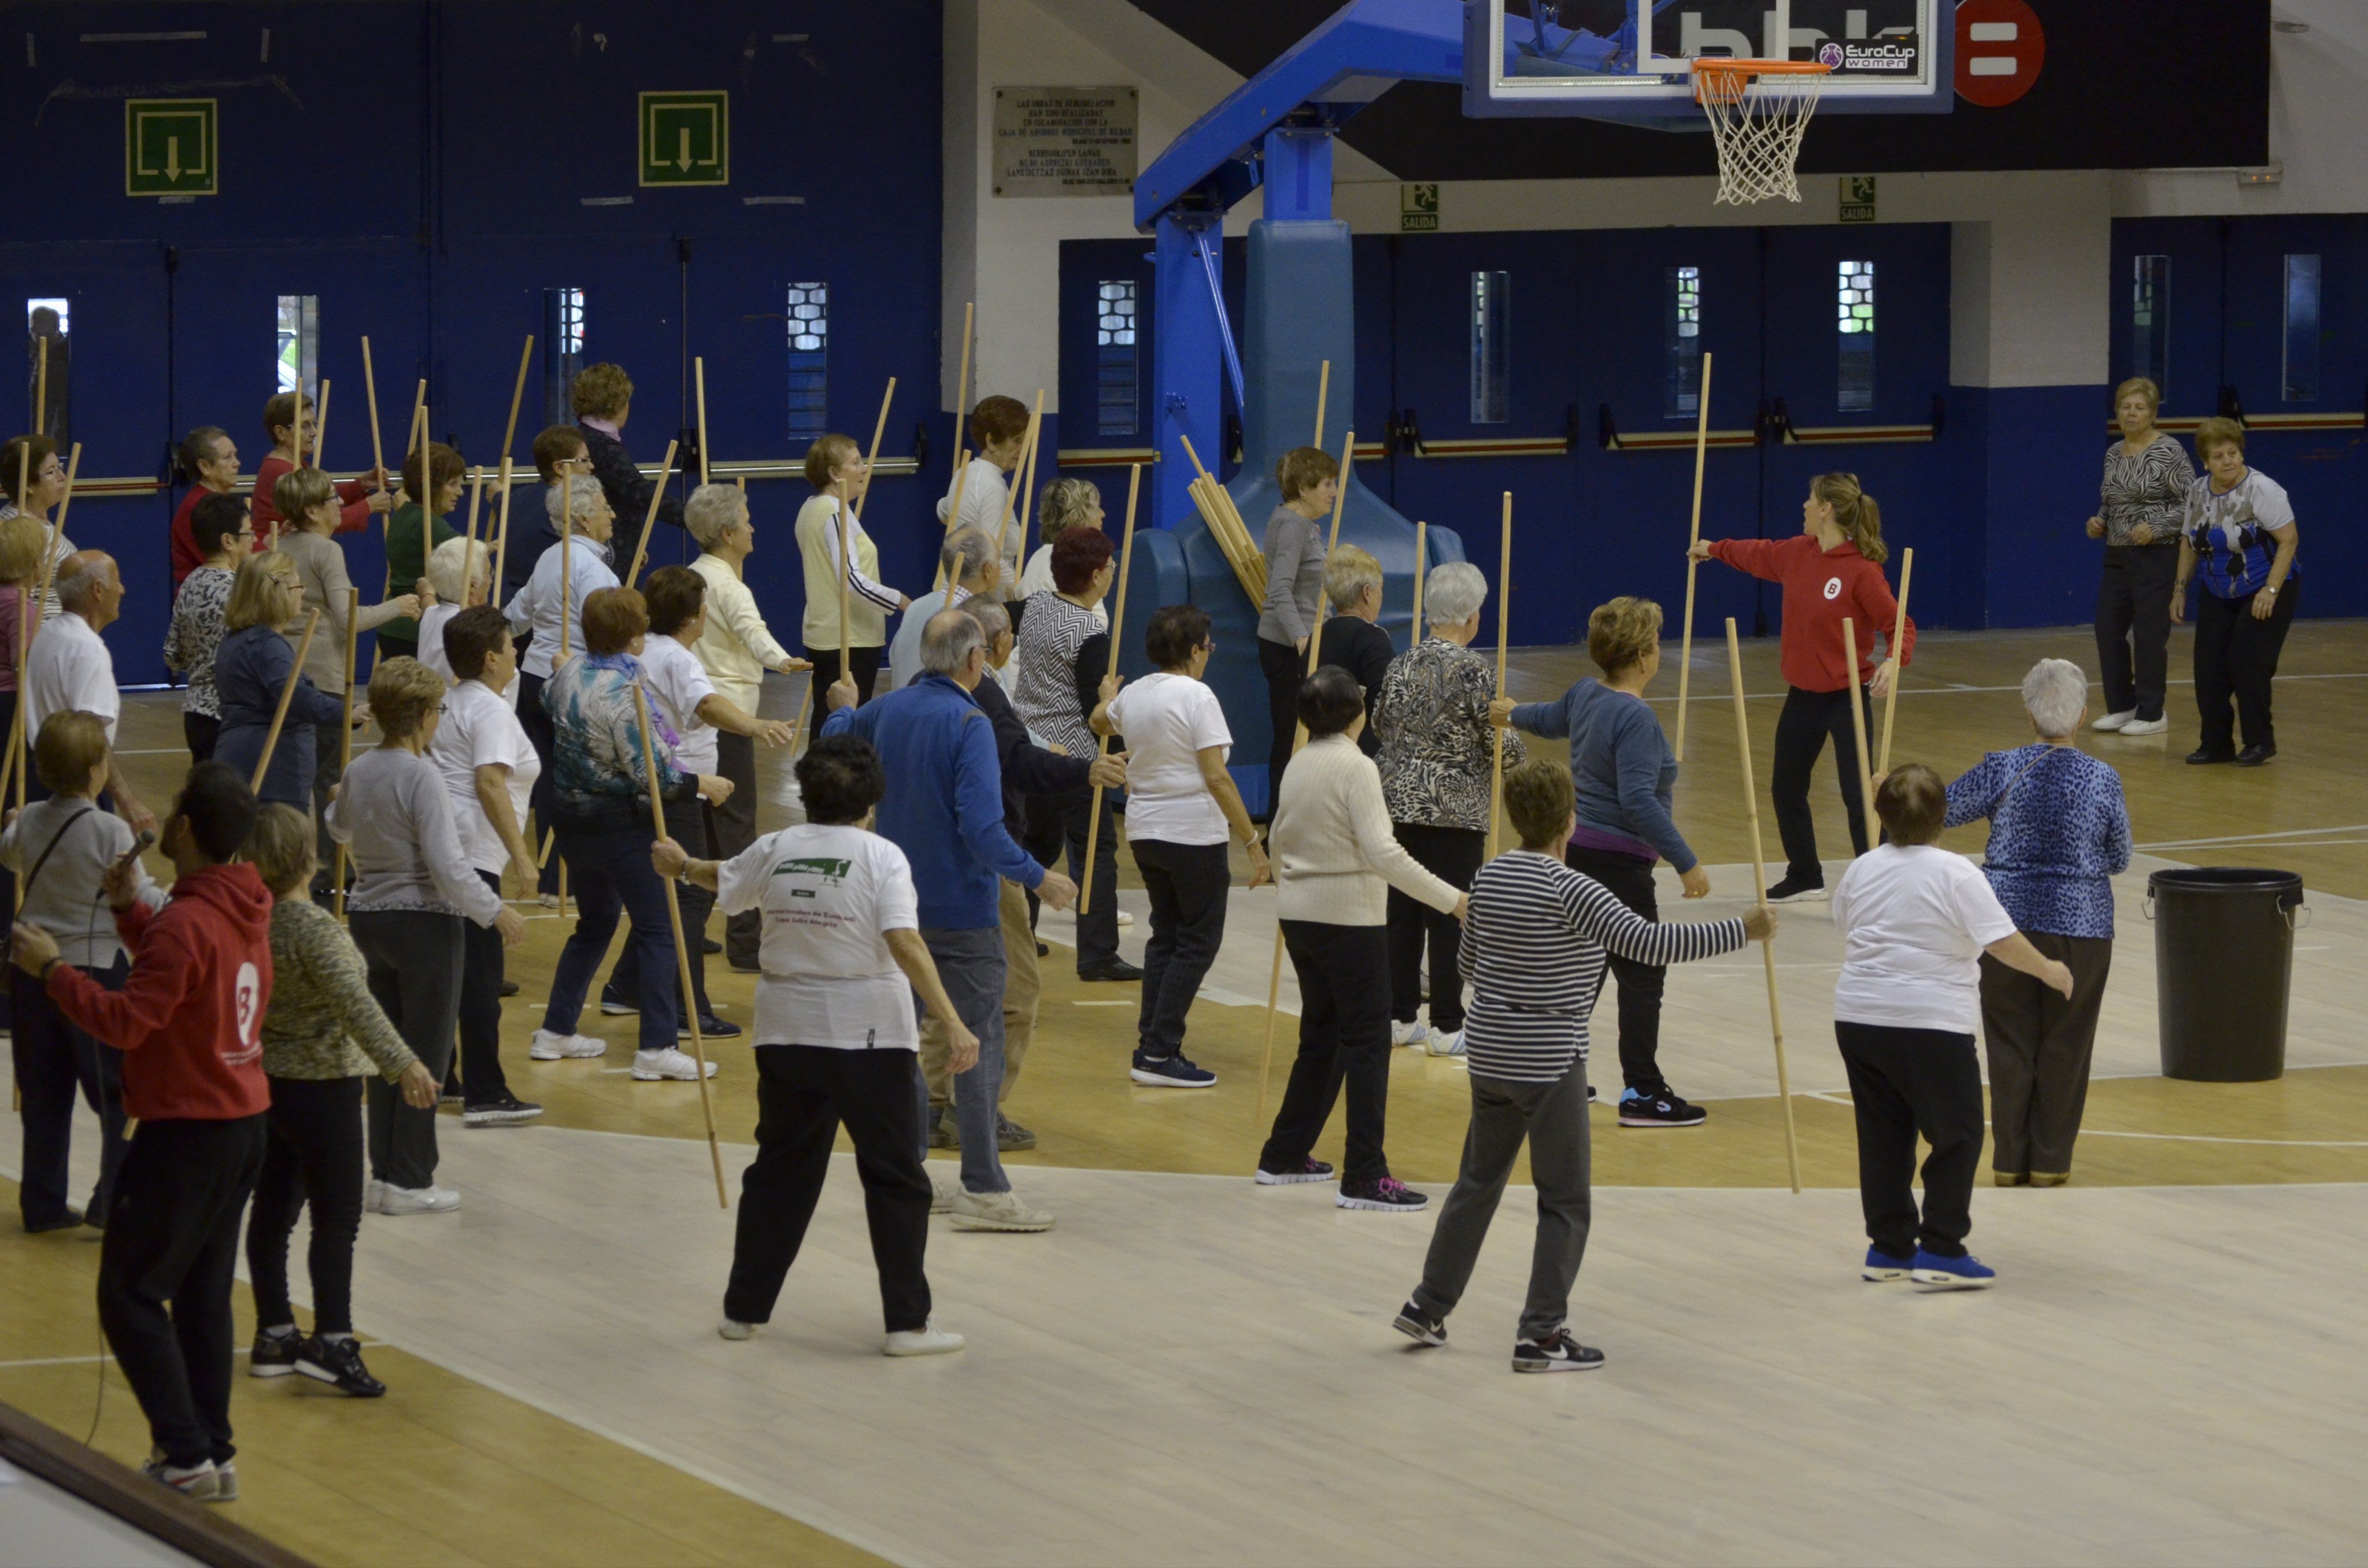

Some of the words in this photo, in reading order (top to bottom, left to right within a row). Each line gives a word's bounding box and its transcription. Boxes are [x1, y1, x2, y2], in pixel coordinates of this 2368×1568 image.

[1846, 45, 1915, 60] EuroCup
[1848, 59, 1906, 67] women
[1017, 100, 1030, 108] LAS
[1032, 99, 1052, 108] OBRAS
[1054, 99, 1063, 108] DE
[1028, 109, 1042, 117] HAN
[1045, 109, 1060, 117] SIDO
[1062, 109, 1103, 117] REALIZADAS
[1023, 118, 1032, 127] EN
[998, 128, 1016, 136] CAJA
[1030, 128, 1059, 136] AHORROS
[1062, 128, 1096, 136] MUNICIPAL
[1098, 127, 1107, 135] DE
[1109, 127, 1133, 135] BILBAO
[1019, 159, 1038, 167] BILBO
[1083, 168, 1098, 176] IZAN
[1841, 208, 1873, 220] SALIDA
[1403, 217, 1436, 228] SALIDA
[1827, 583, 1837, 594] B
[238, 986, 251, 1026] B
